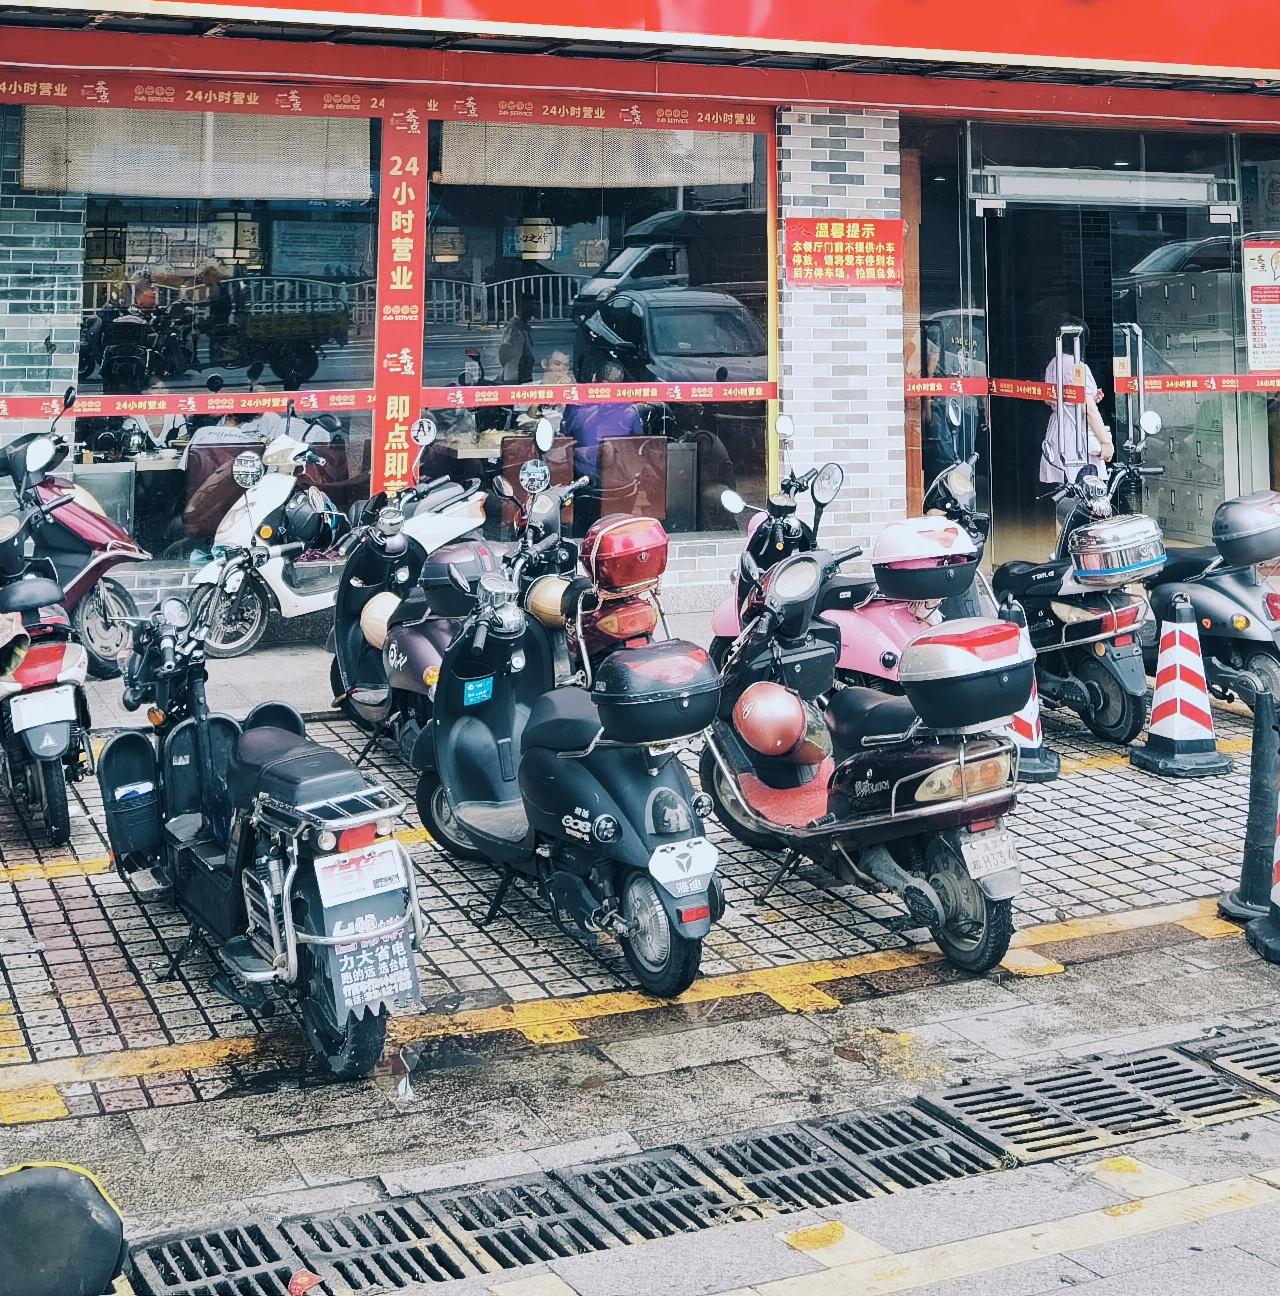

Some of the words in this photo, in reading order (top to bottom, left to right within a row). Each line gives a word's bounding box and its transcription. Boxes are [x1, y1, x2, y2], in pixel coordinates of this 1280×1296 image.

[185, 90, 260, 105] 24小时营业
[542, 105, 605, 119] 24小时营业
[697, 112, 756, 125] 24小时营业
[388, 155, 420, 290] 24小时营业
[815, 222, 876, 239] 温馨提示
